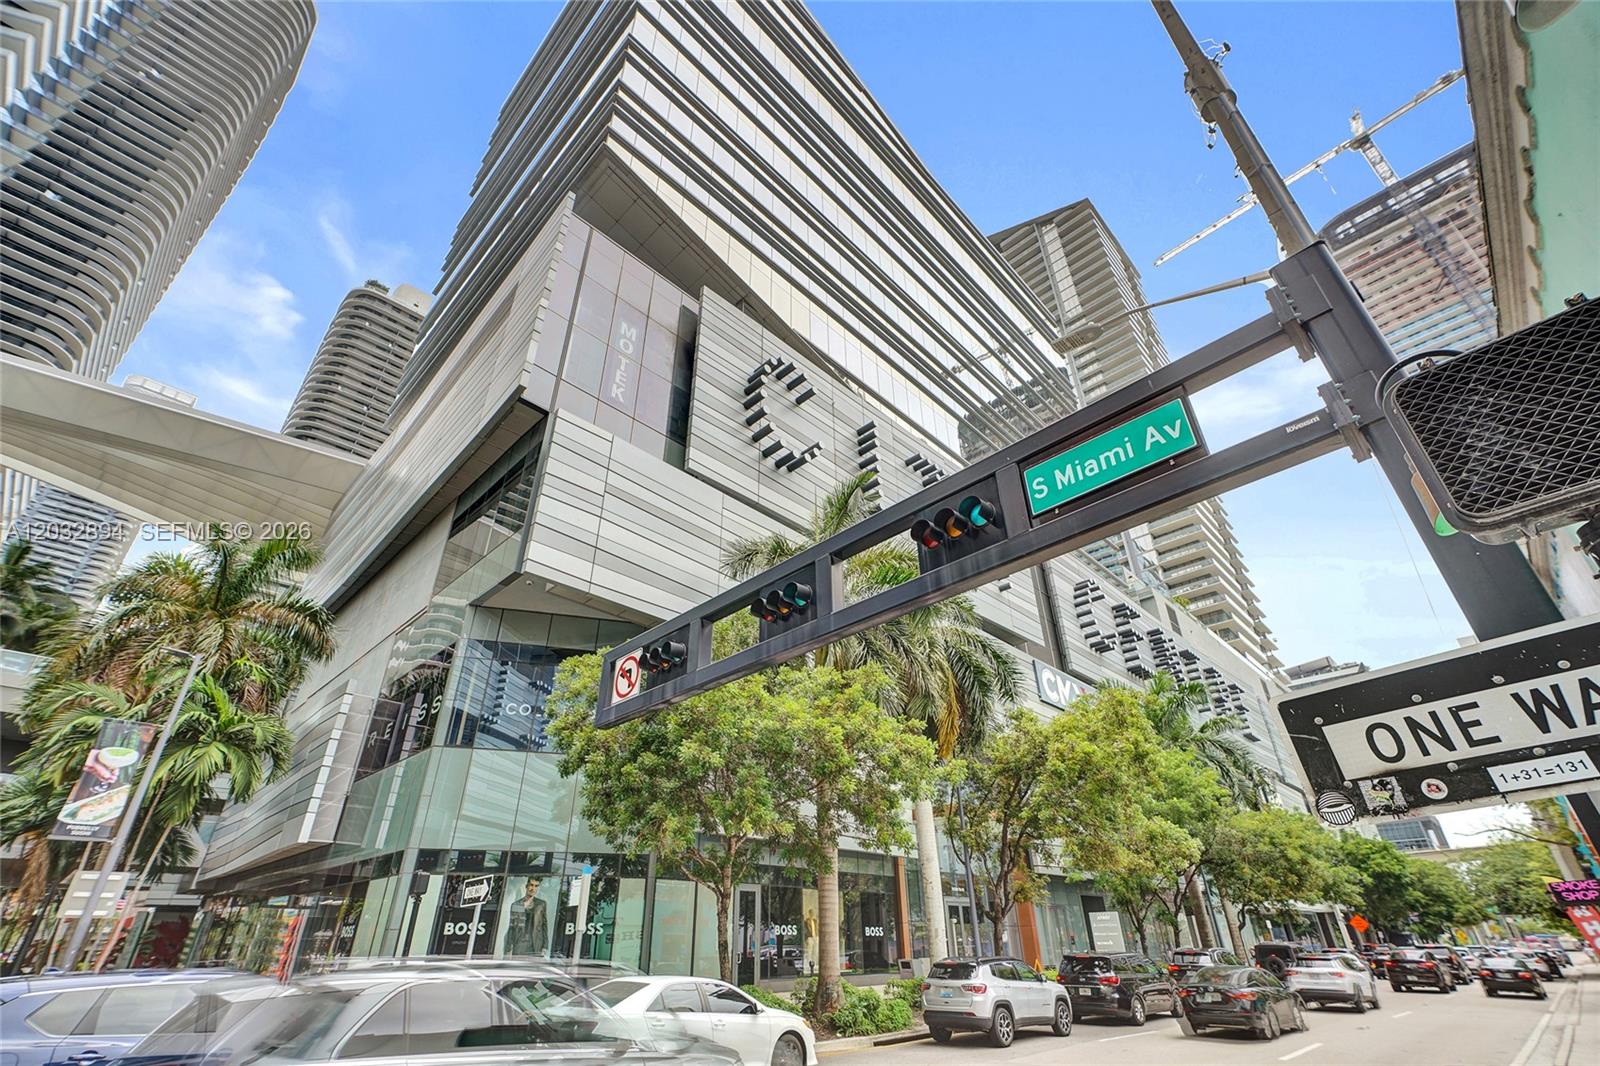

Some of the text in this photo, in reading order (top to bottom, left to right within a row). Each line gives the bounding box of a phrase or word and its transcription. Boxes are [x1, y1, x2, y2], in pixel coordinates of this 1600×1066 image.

[1033, 419, 1182, 500] S Miami Av
[368, 695, 442, 747] REISS
[1365, 701, 1502, 763] ONE
[1499, 759, 1589, 784] 1+31=131
[1551, 880, 1600, 892] SMOKE
[1561, 890, 1599, 901] SHOP
[774, 924, 798, 936] BOSS
[865, 926, 884, 937] BOSS
